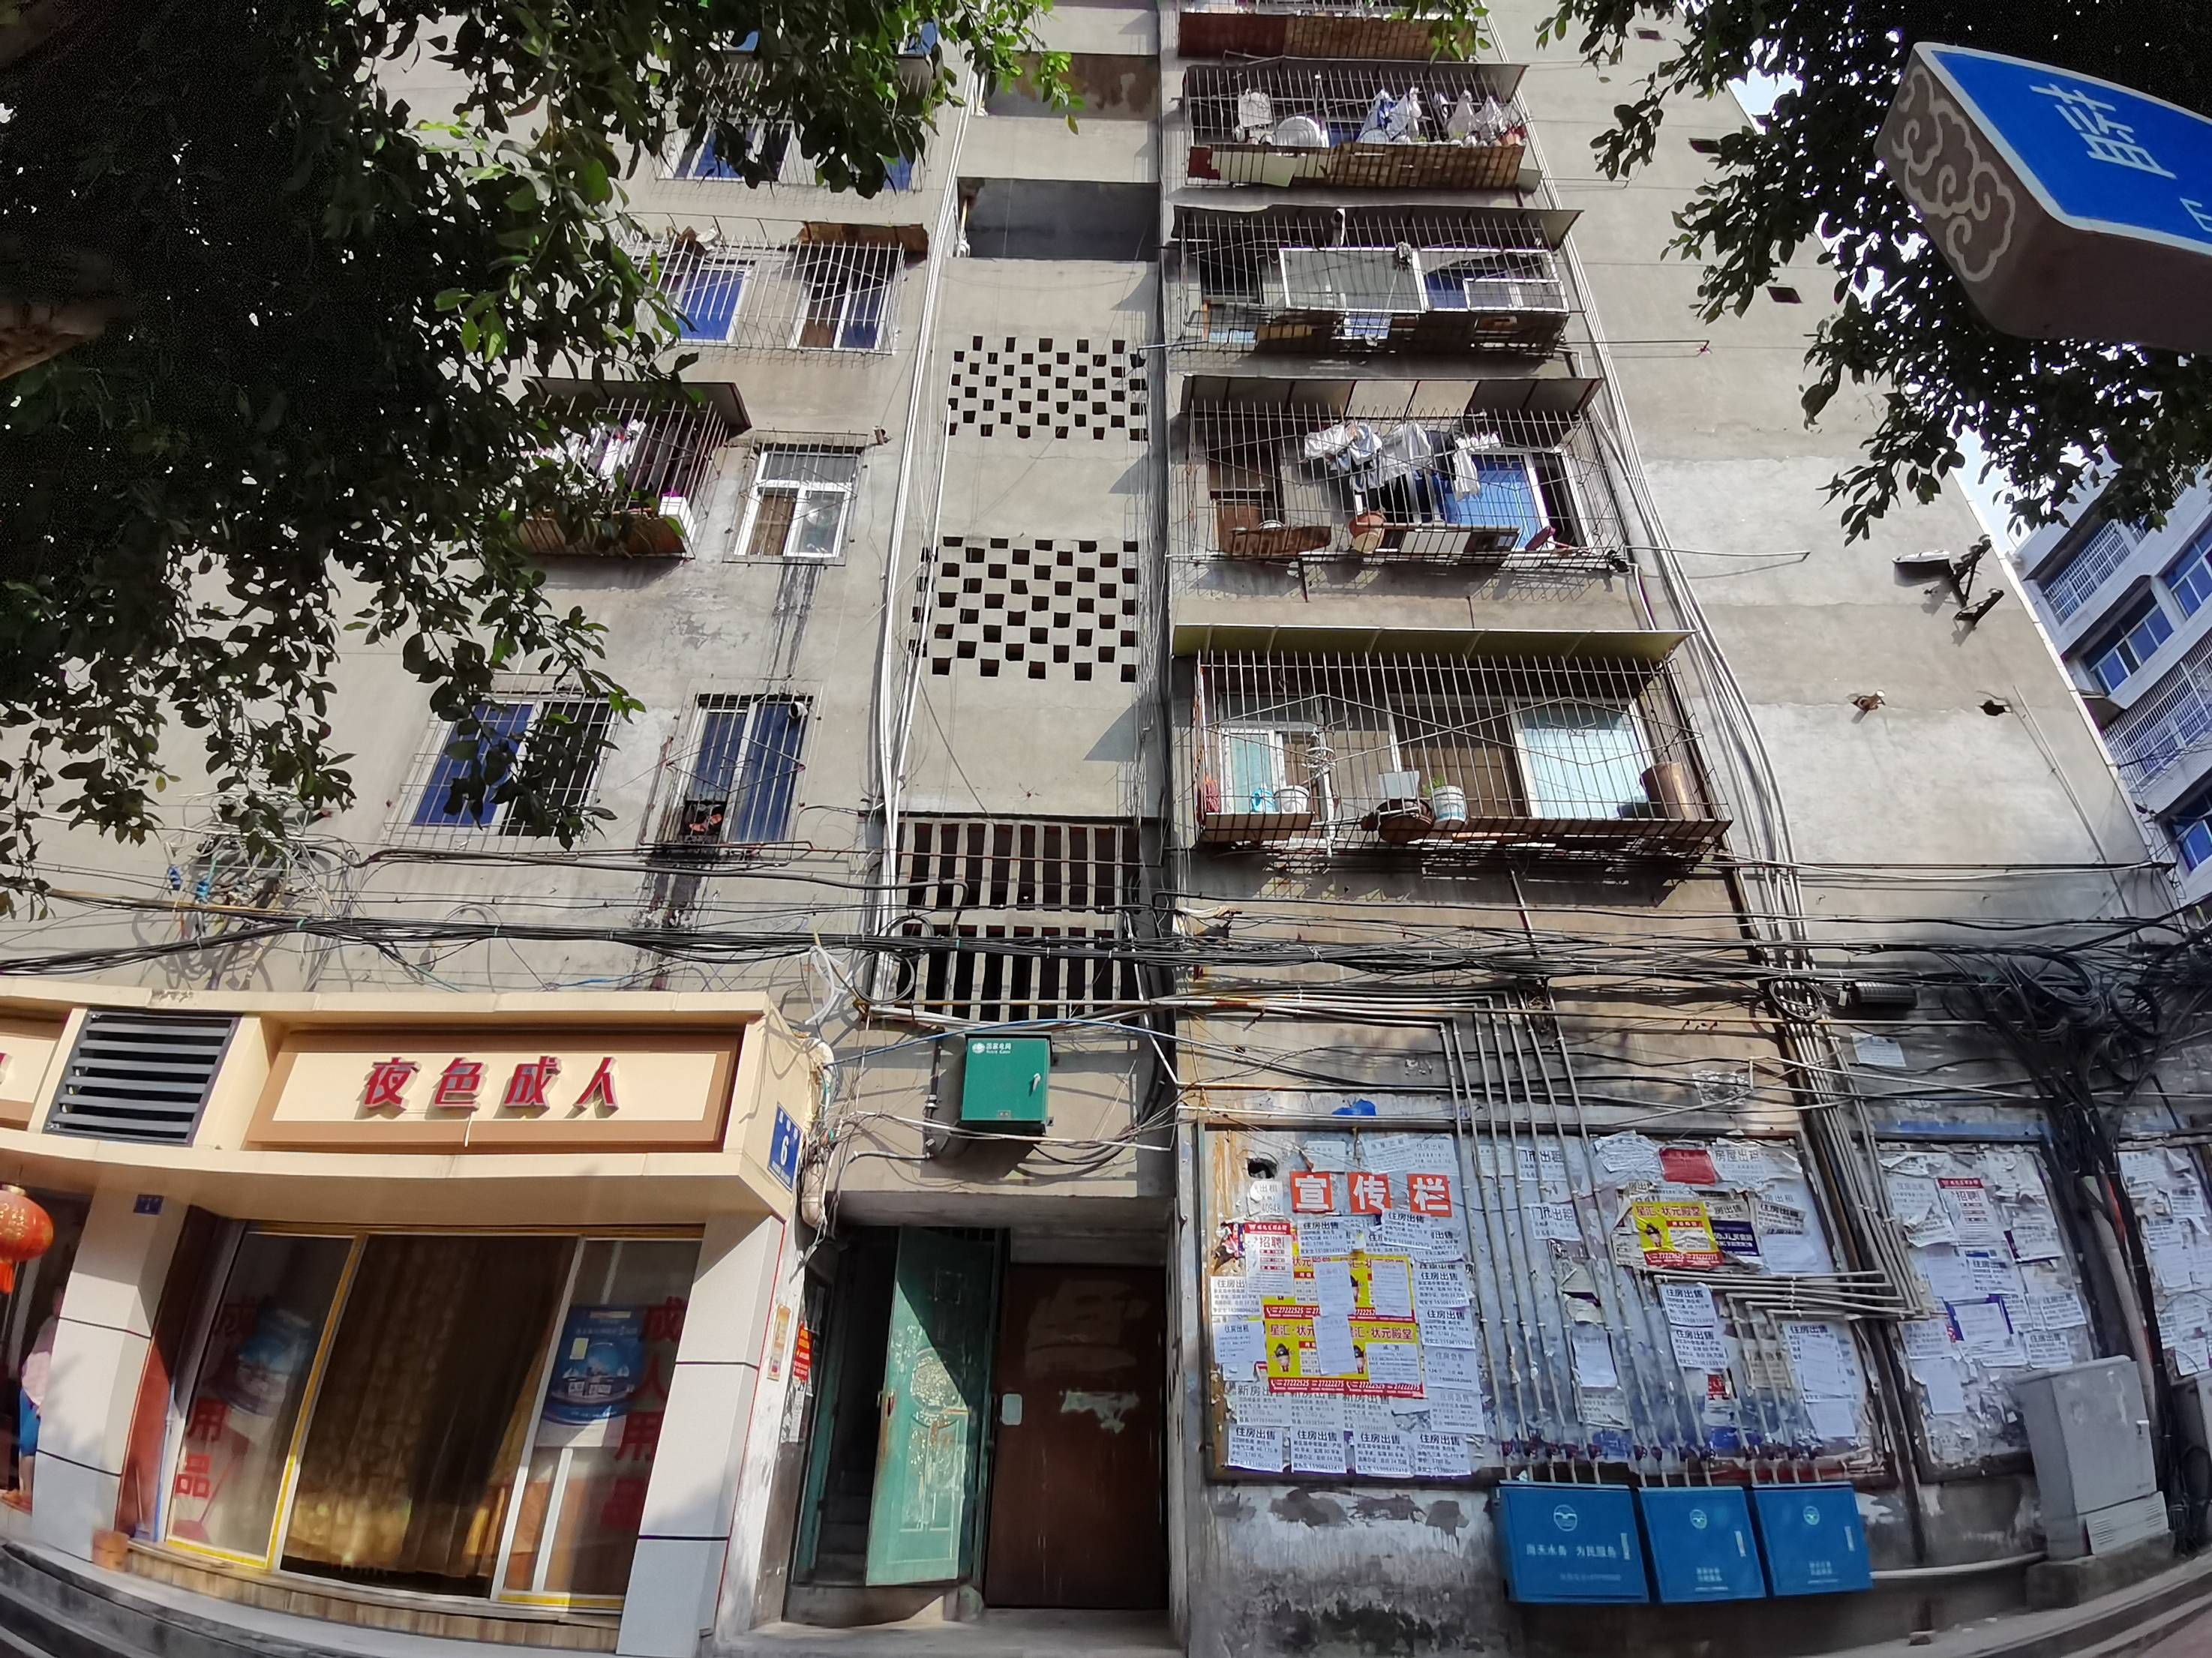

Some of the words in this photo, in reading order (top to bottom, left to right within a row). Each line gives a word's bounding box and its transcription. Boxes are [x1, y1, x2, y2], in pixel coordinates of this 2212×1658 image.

[2029, 82, 2177, 180] 盐
[365, 1056, 620, 1111] 夜色成人
[780, 1135, 789, 1166] 6
[1294, 1174, 1449, 1212] 宣传栏
[1388, 1213, 1424, 1223] 住房出售
[1532, 1205, 1574, 1222] 门市出租
[1304, 1222, 1339, 1230] 住房出售
[1421, 1272, 1458, 1281] 住房出售
[1667, 1288, 1704, 1298] 住房出售
[1427, 1309, 1465, 1320] 住房出售
[1790, 1324, 1828, 1334] 住房出售
[1676, 1330, 1715, 1340] 住房出售
[1236, 1427, 1275, 1440] 住房出售
[1297, 1429, 1337, 1441] 住房出售
[1361, 1433, 1400, 1444] 住房出售
[1420, 1433, 1460, 1446] 住房出售
